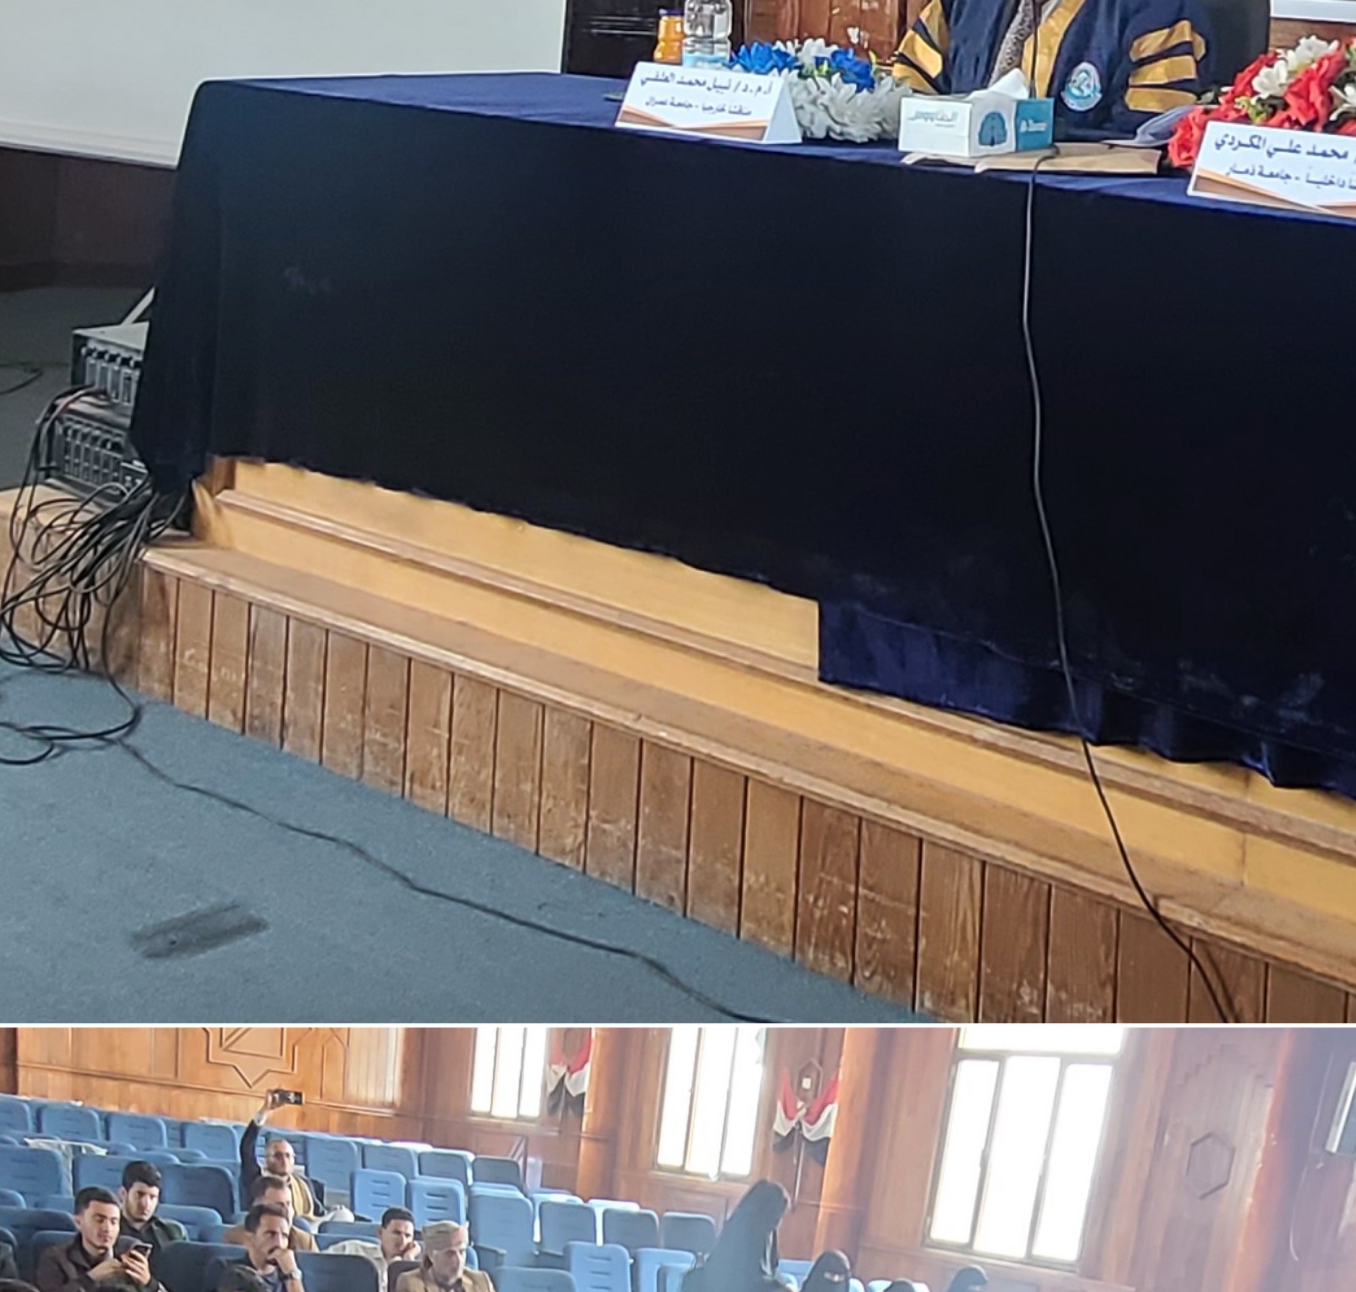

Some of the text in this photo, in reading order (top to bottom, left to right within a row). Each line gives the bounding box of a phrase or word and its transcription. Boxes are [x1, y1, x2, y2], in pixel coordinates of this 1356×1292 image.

[677, 77, 706, 87] محمد
[1214, 133, 1266, 152] الكردي
[1266, 139, 1301, 158] علي
[1307, 144, 1349, 160] محمد
[1258, 165, 1292, 182] جامعة
